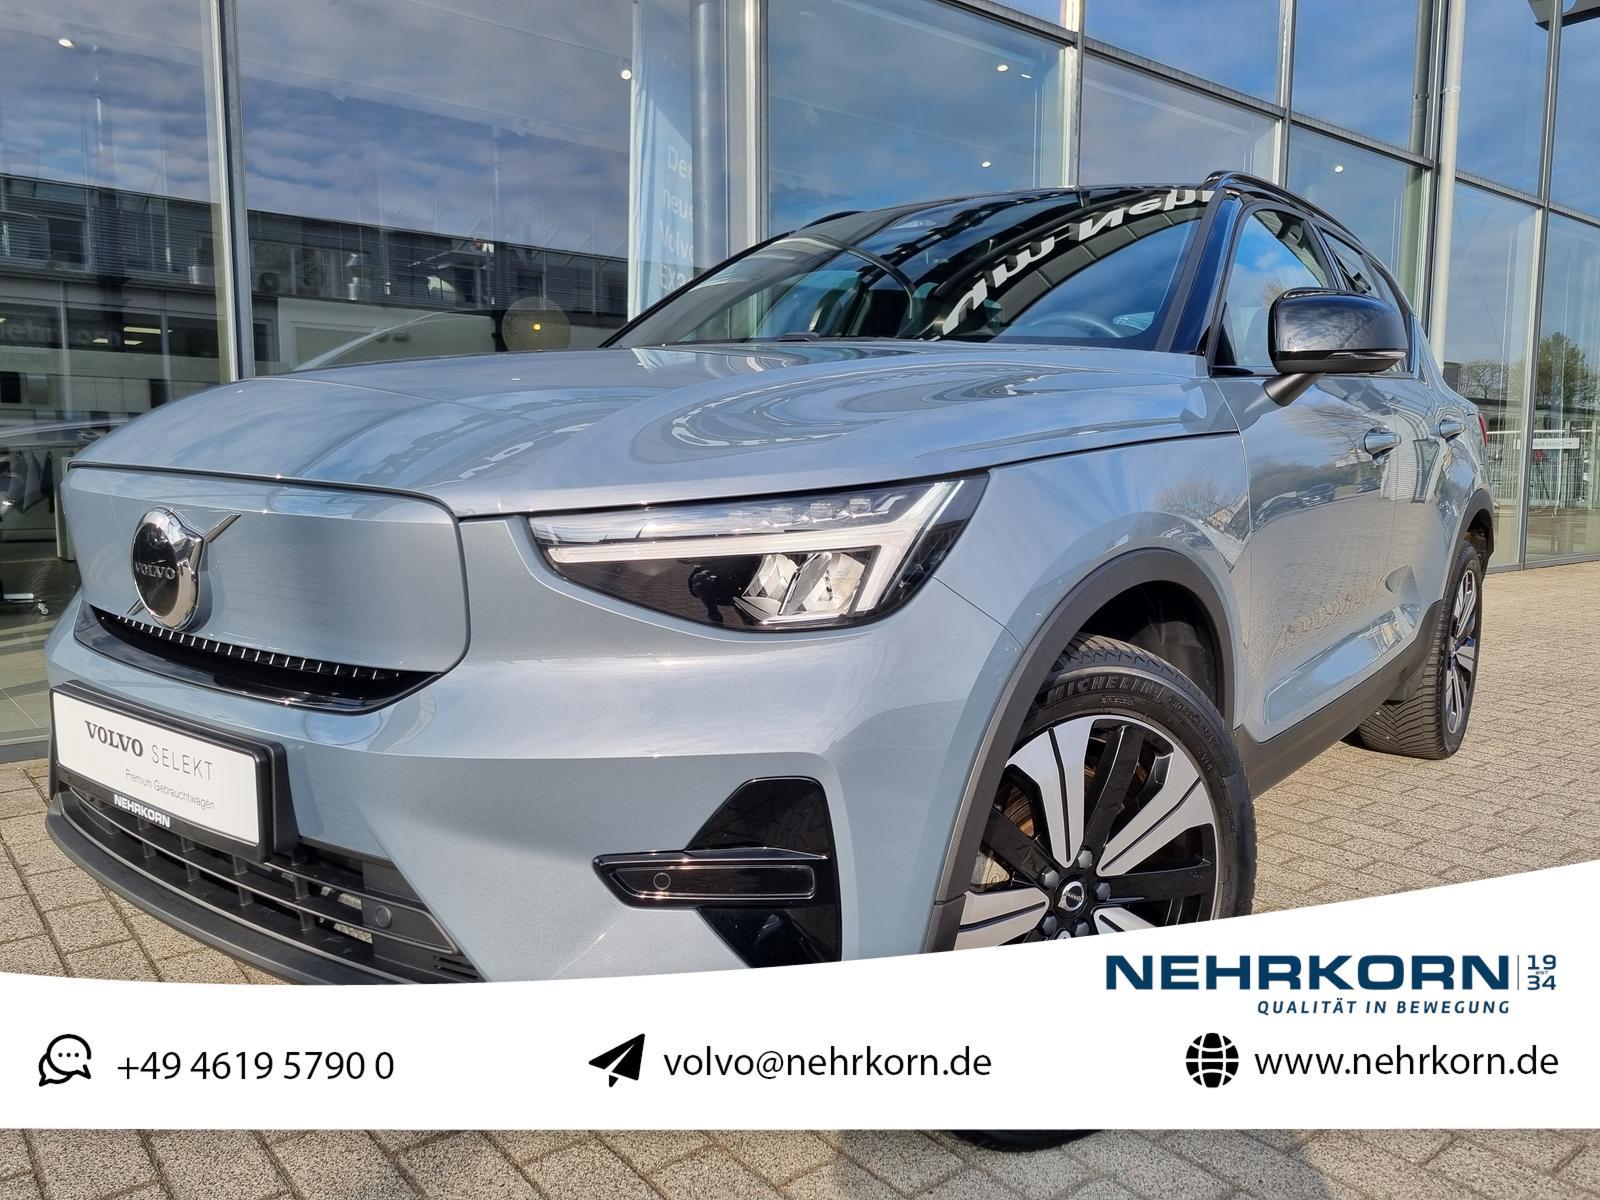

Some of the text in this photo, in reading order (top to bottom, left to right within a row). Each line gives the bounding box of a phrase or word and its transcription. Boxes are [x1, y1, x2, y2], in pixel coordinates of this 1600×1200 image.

[135, 562, 176, 580] VOLVO
[1047, 675, 1157, 705] MICHELIN
[84, 720, 214, 781] VOLVO SELEKT
[125, 768, 216, 811] Premium Gebrauchtwagen
[113, 793, 171, 828] NEHRKORN
